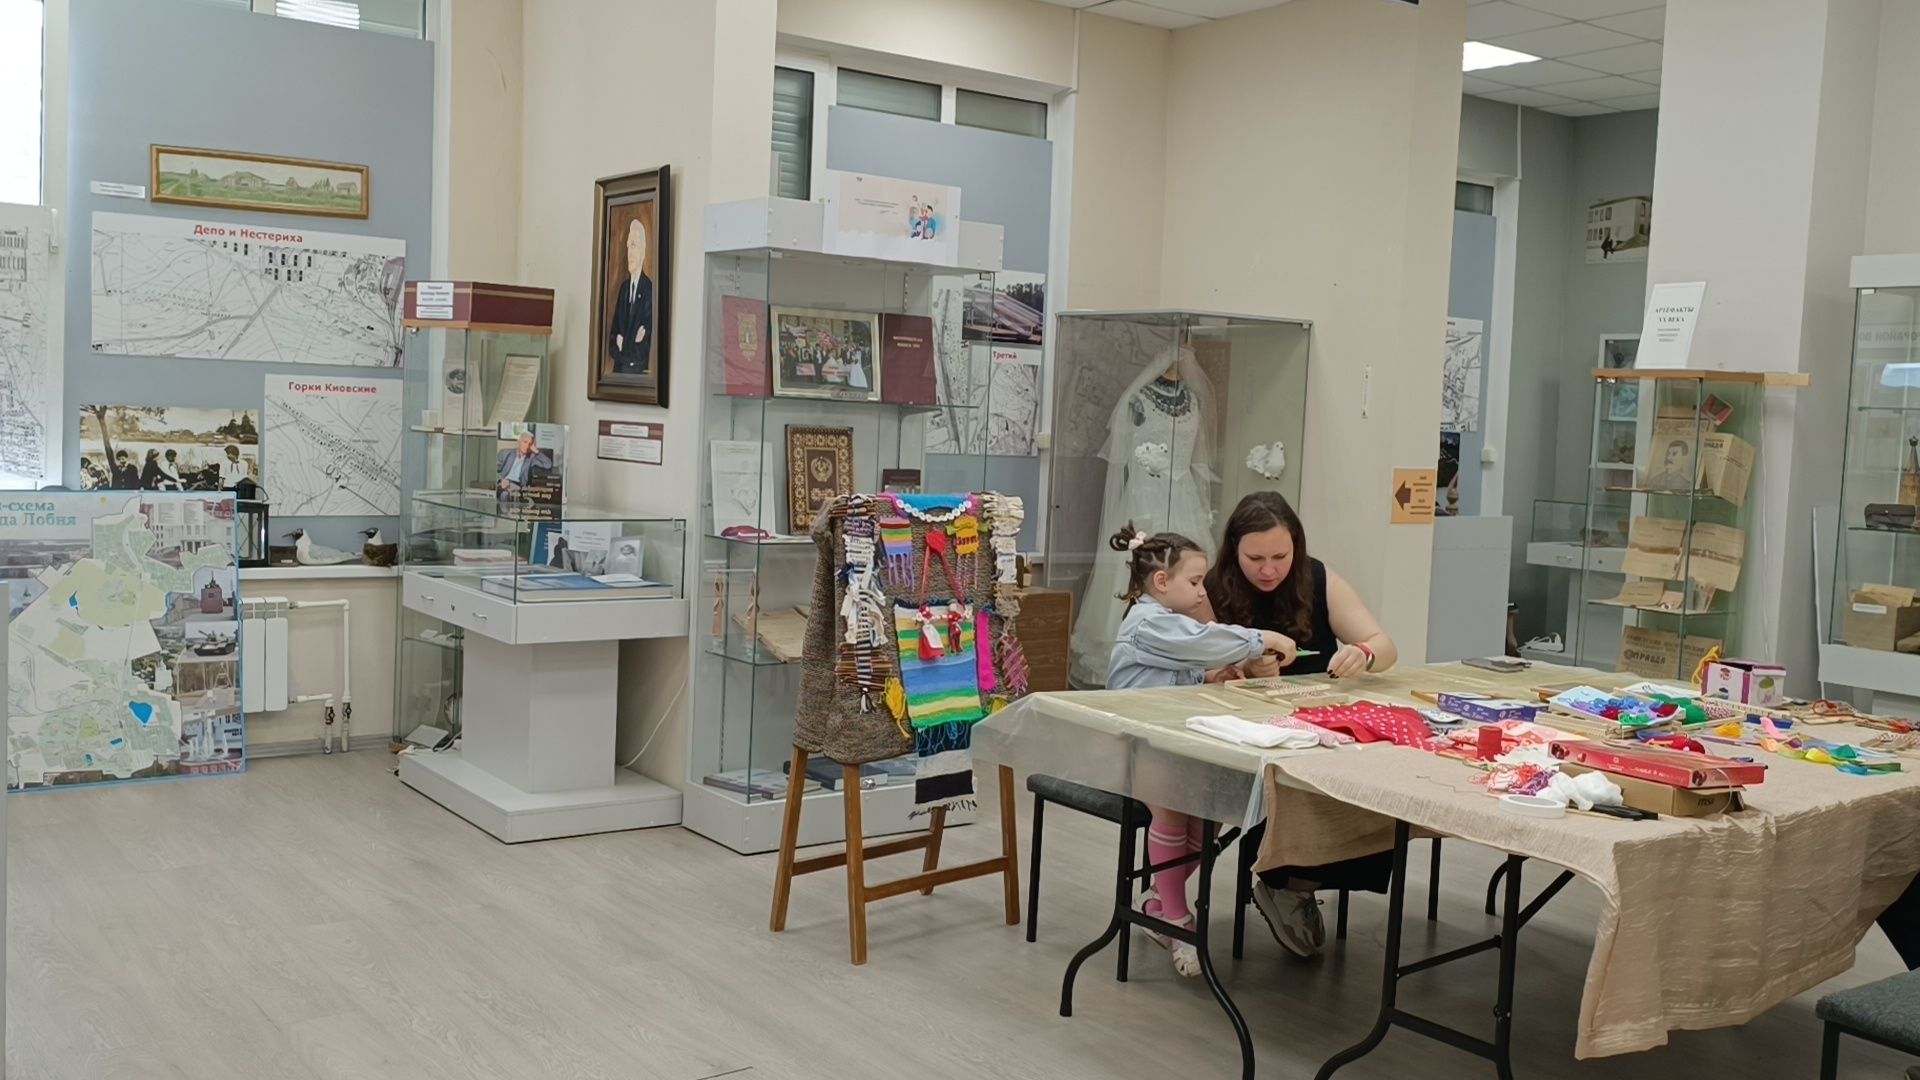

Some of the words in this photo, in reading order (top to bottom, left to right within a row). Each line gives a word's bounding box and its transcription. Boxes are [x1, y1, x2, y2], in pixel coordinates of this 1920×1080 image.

[193, 224, 226, 236] Депо
[229, 229, 236, 237] и
[240, 228, 303, 243] Нестериха
[993, 351, 1017, 360] Третий
[288, 381, 321, 392] Горки
[325, 383, 377, 394] Киовские
[22, 512, 77, 526] Лобня
